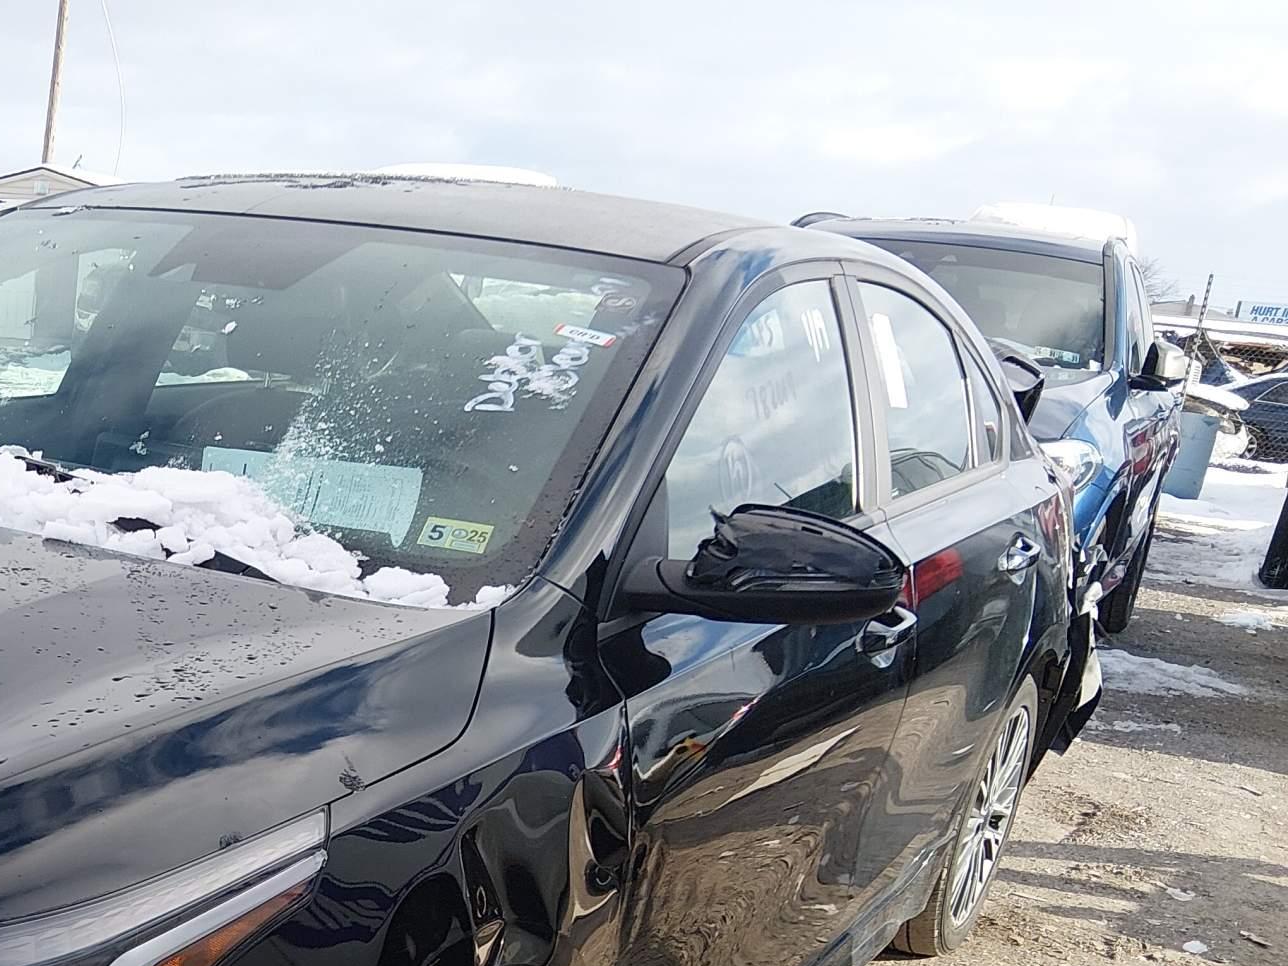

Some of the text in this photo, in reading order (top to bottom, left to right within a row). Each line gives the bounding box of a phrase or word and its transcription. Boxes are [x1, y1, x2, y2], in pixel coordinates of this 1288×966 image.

[1249, 305, 1281, 317] HURT
[427, 524, 489, 544] 5 25
